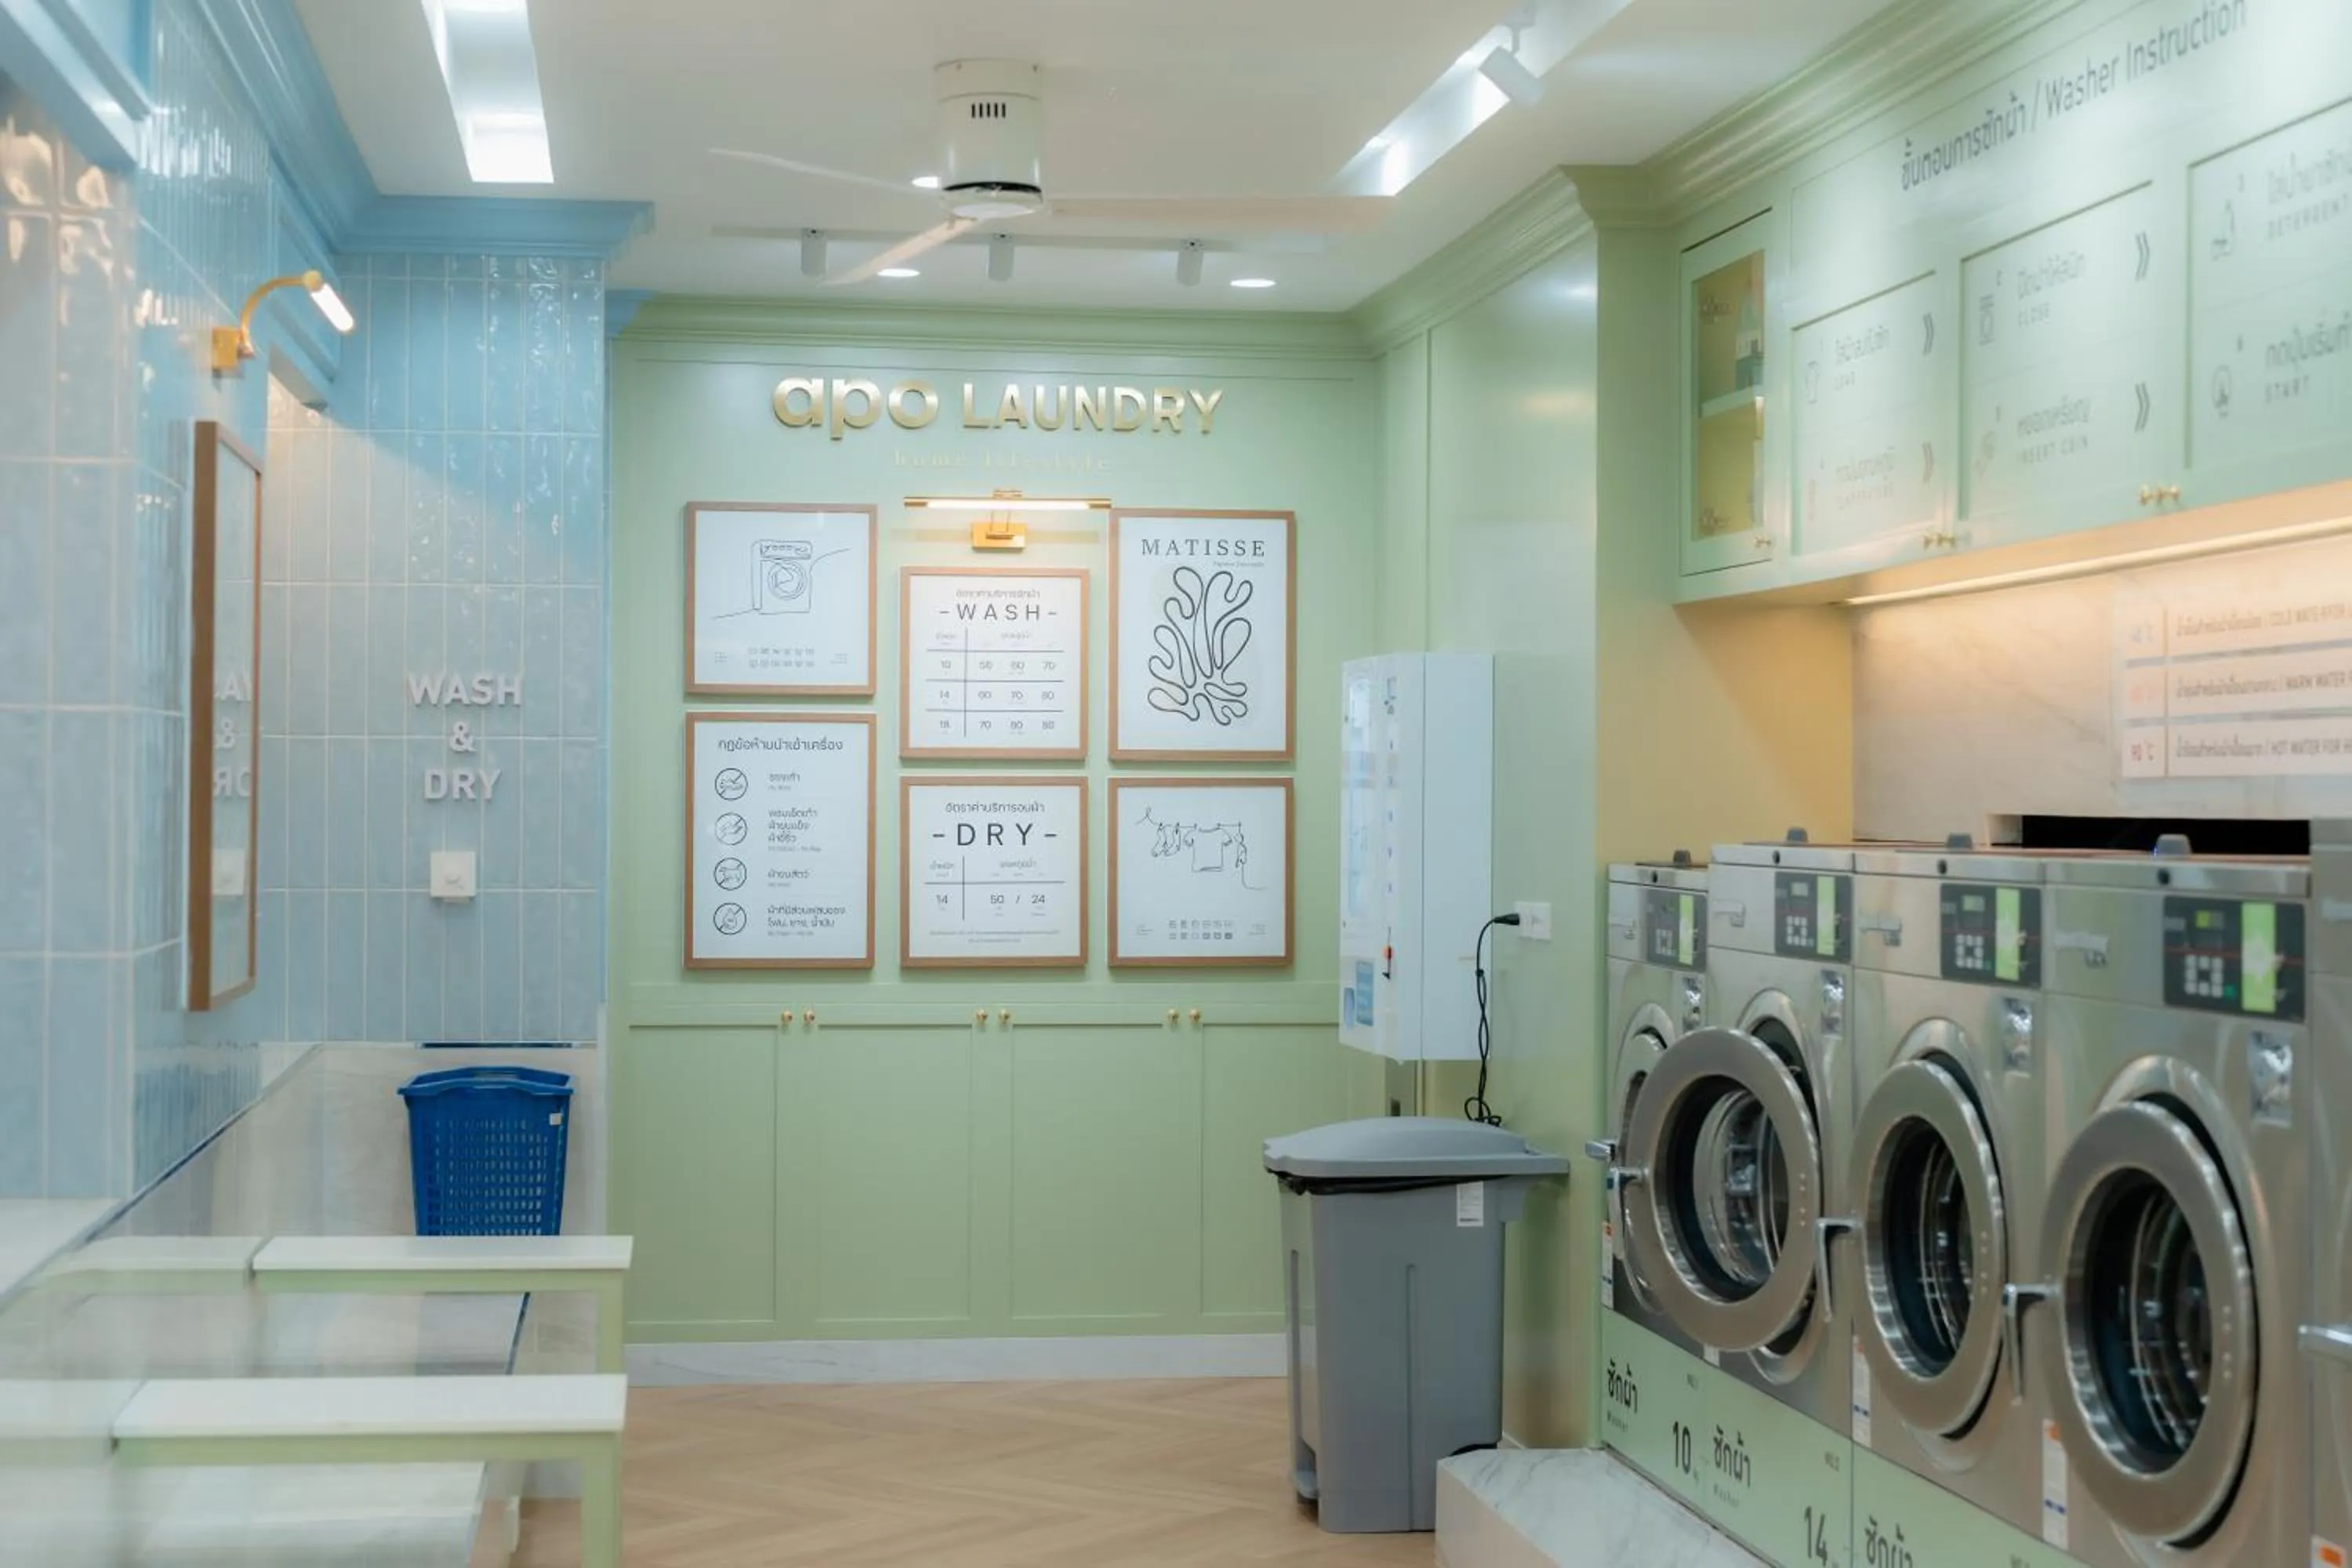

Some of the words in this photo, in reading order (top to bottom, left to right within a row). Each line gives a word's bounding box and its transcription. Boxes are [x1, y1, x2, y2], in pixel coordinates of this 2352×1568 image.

[2044, 55, 2118, 122] Washer
[2126, 0, 2245, 82] Instruction
[771, 377, 939, 441] apo
[962, 383, 1222, 434] LAUNDRY
[1142, 539, 1265, 557] MATISSE
[408, 672, 524, 705] WASH
[449, 720, 477, 752] &
[423, 768, 501, 800] DRY
[936, 895, 949, 904] 14
[1032, 895, 1046, 904] 24
[1607, 1359, 1638, 1414] ซักผ้า
[1672, 1421, 1692, 1475] 10
[1713, 1424, 1751, 1488] ซักผ้า
[1804, 1505, 1828, 1567] 14
